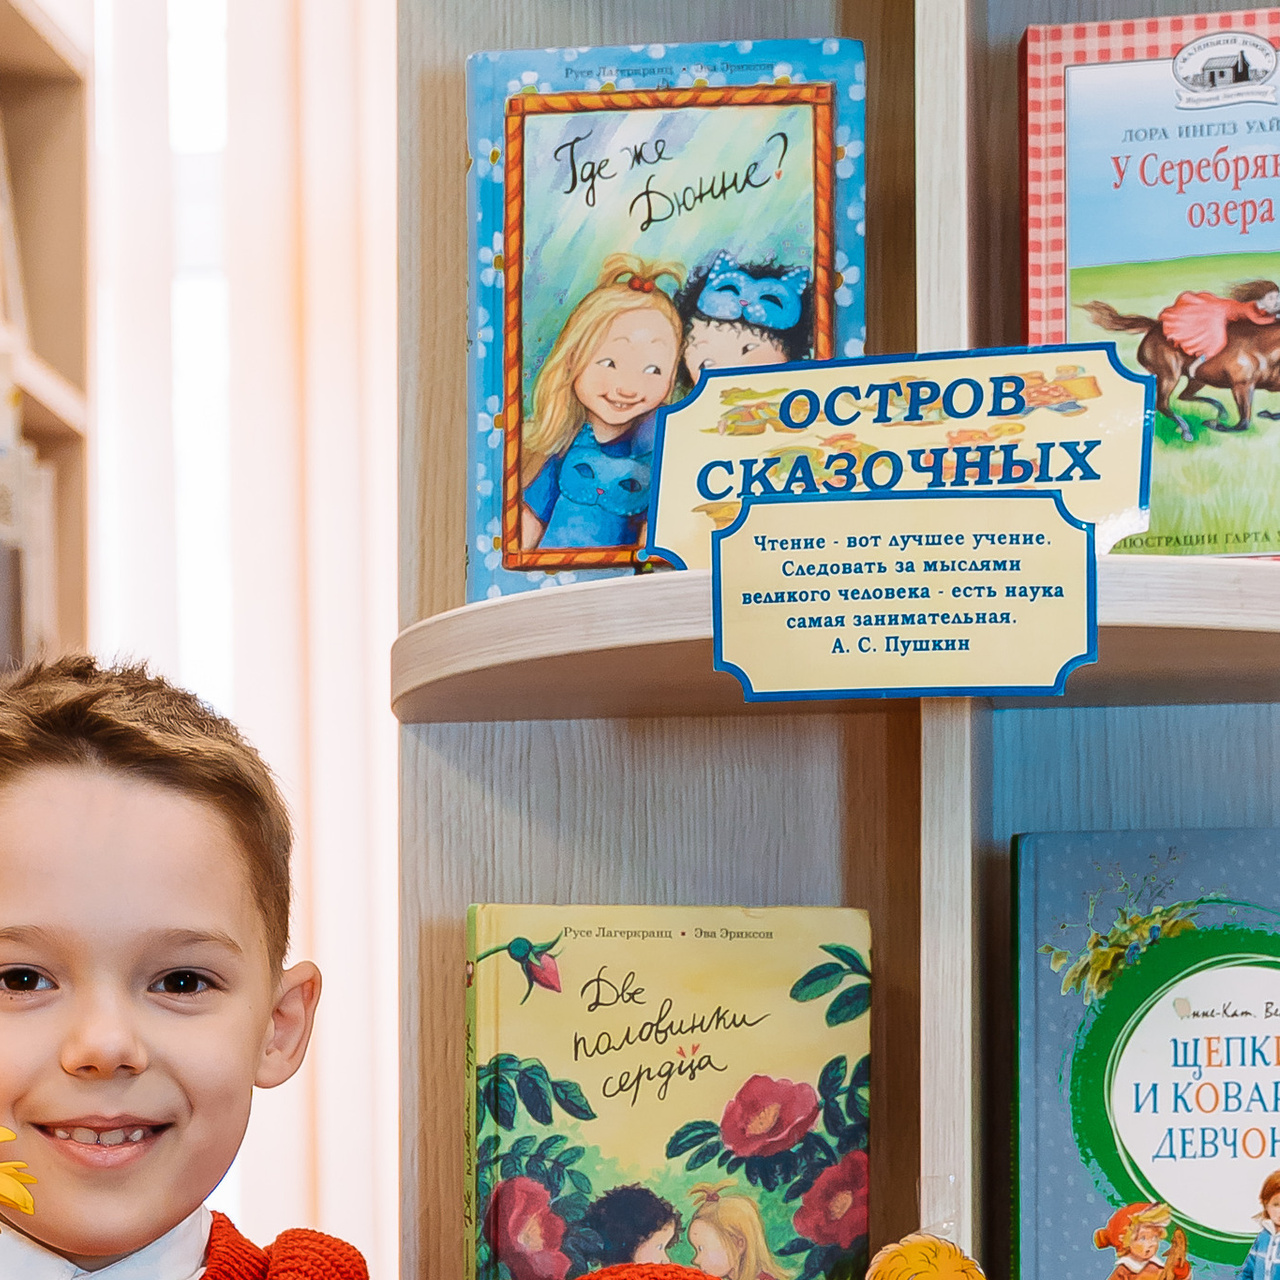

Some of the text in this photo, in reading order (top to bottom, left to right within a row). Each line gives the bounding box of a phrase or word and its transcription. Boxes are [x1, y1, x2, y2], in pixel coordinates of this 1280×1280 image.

[1122, 127, 1169, 143] ЛОРА
[1178, 120, 1238, 138] ИНГЛЗ
[620, 138, 673, 170] же
[1111, 155, 1131, 189] У
[1187, 198, 1275, 235] озера
[778, 375, 1027, 429] ОСТРОВ
[696, 440, 1102, 502] СКАЗОЧНЫХ
[754, 535, 826, 551] Чтение
[847, 535, 881, 548] вот
[888, 533, 965, 550] лучшее
[972, 532, 1051, 546] учение.
[782, 558, 1021, 577] Следовать за мыслями
[742, 589, 831, 605] великого
[838, 585, 930, 601] человека
[952, 584, 997, 598] есть
[1005, 583, 1064, 602] наука
[786, 610, 1017, 629] самая занимательная.
[832, 636, 970, 656] А. С. Пушкин
[564, 927, 673, 939] Русе Лагеркранц
[695, 928, 773, 940] Эва Эриксон
[580, 965, 647, 1012] Две
[1180, 1002, 1257, 1019] нне-Кат.
[574, 998, 772, 1061] половинки
[602, 1054, 728, 1107] сердца
[1133, 1082, 1159, 1114] И
